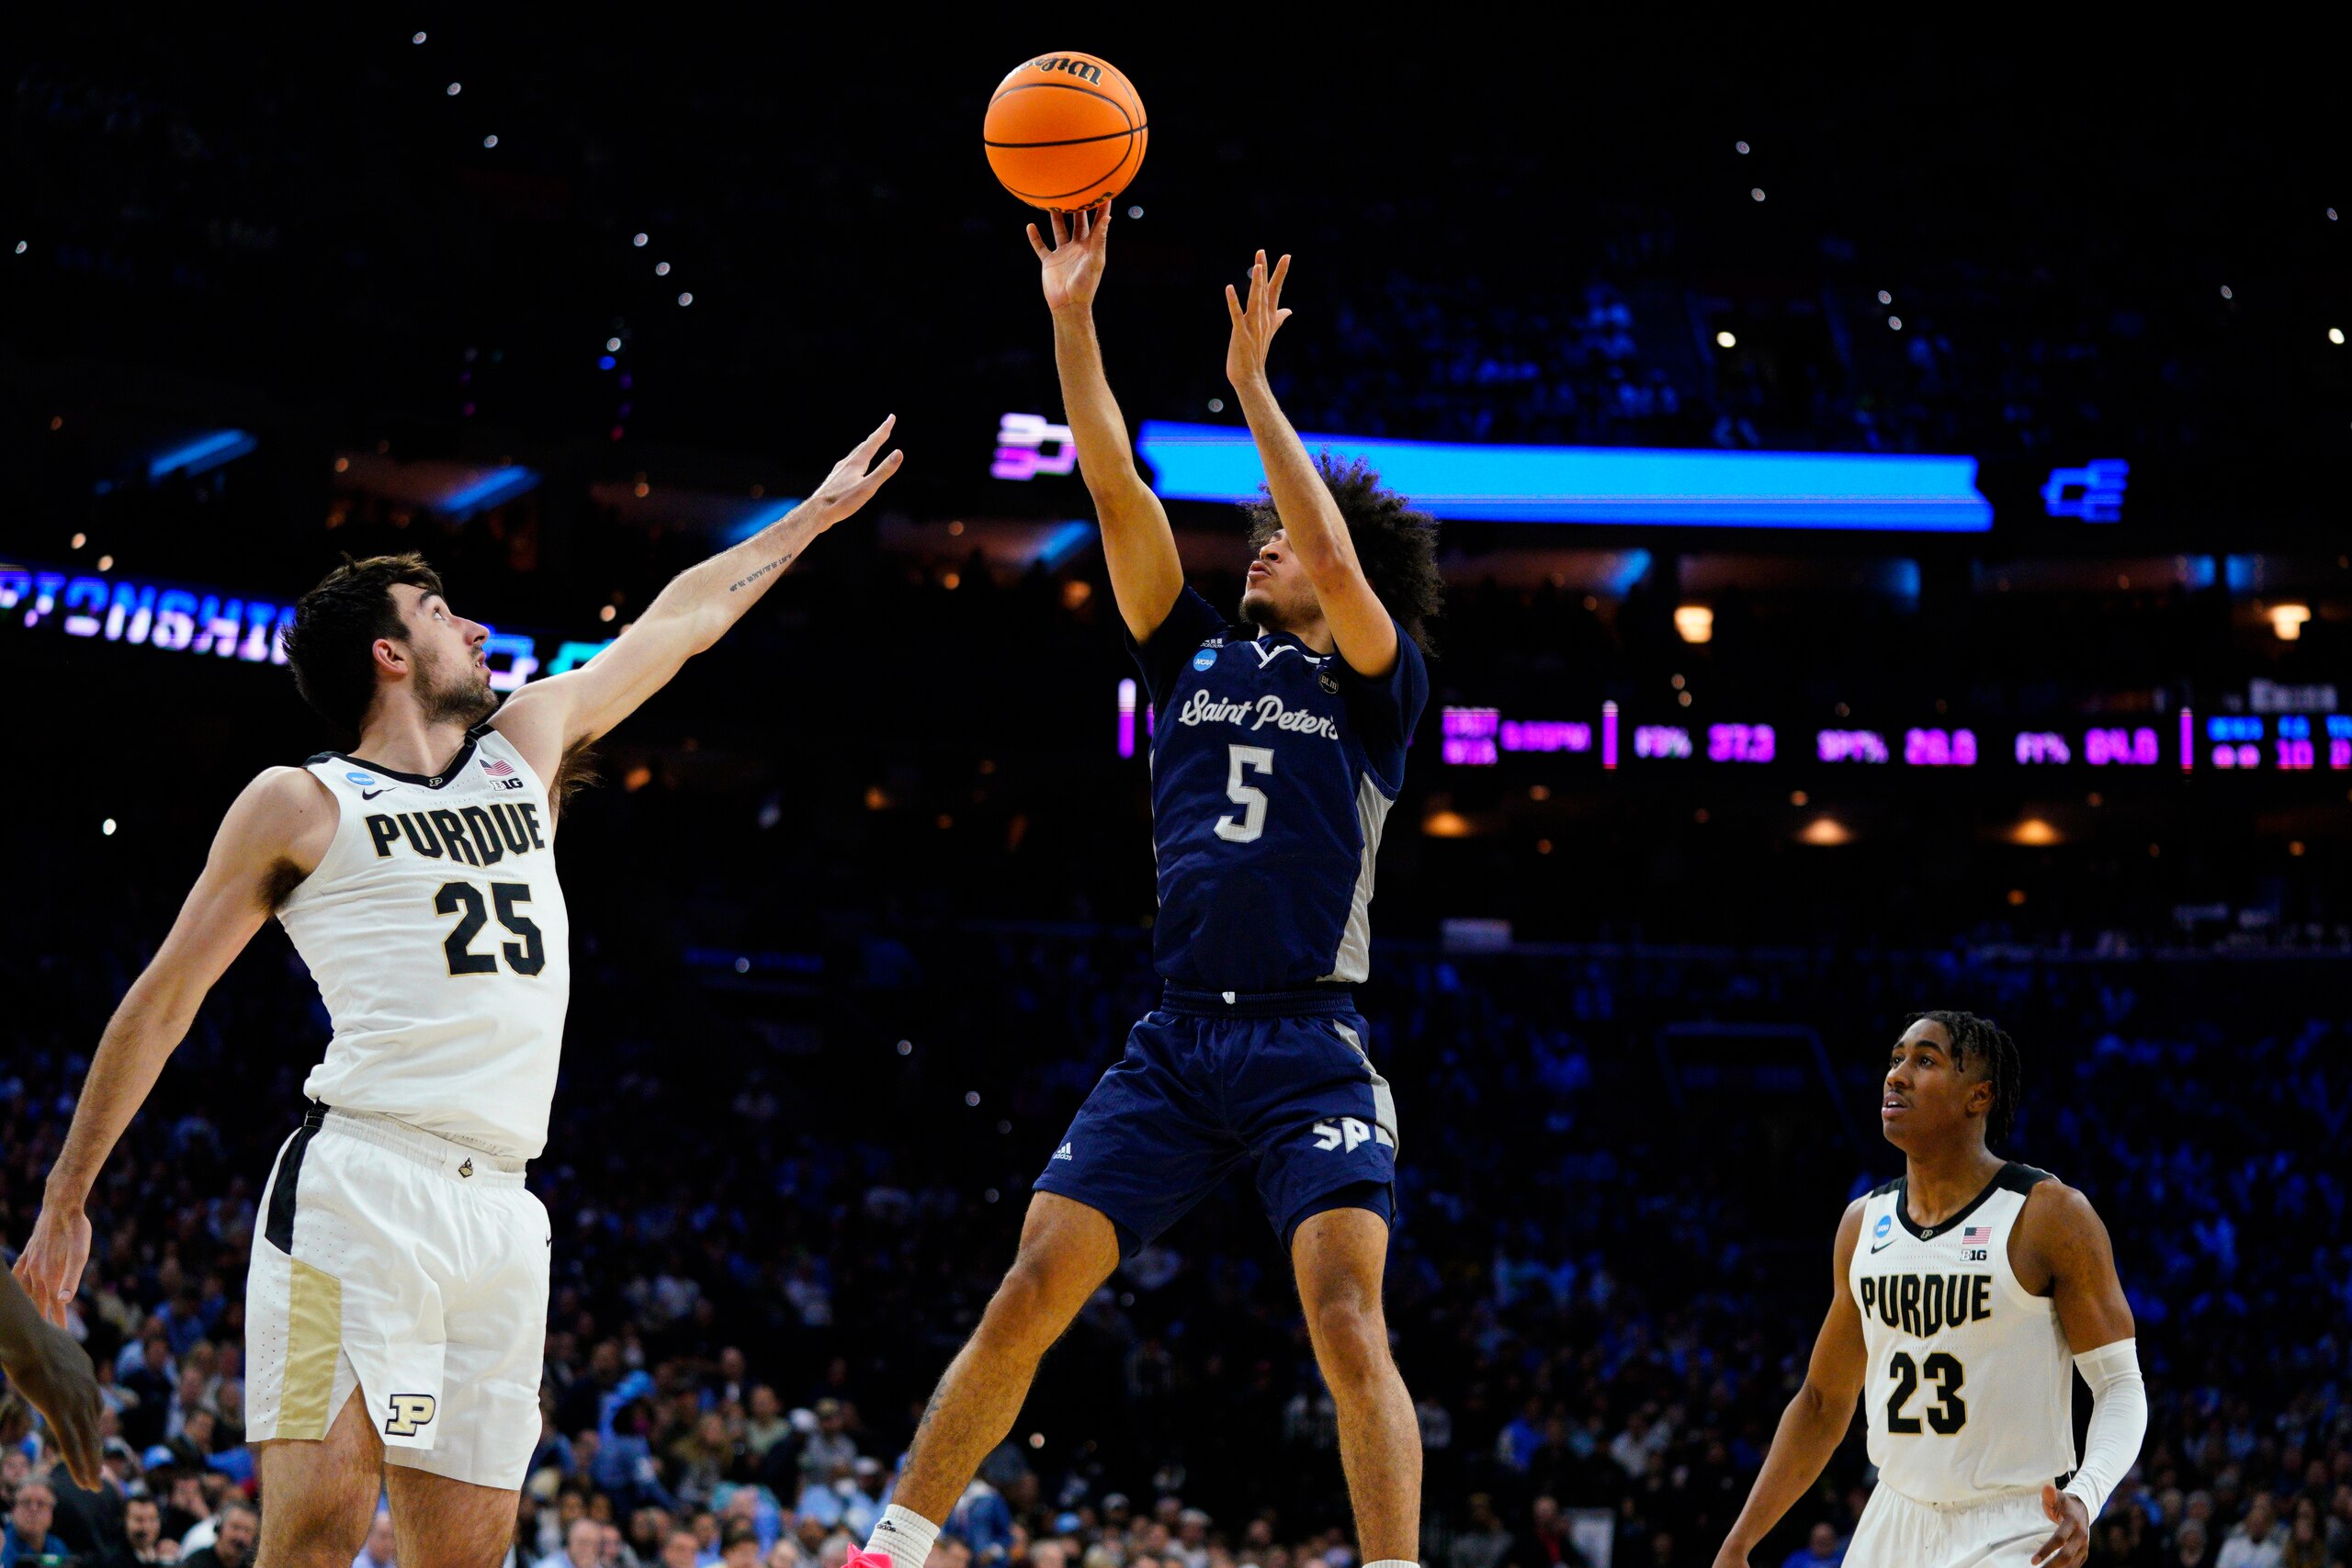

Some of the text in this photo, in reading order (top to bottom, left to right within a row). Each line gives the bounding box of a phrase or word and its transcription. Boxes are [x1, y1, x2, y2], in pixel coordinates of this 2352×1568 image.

[1179, 689, 1252, 727] Saint
[1213, 743, 1275, 843] 5
[364, 803, 546, 869] PURDUE
[432, 881, 547, 978] 25
[1860, 1274, 1993, 1340] PURDUE
[384, 1393, 436, 1437] P
[1886, 1351, 1968, 1438] 23
